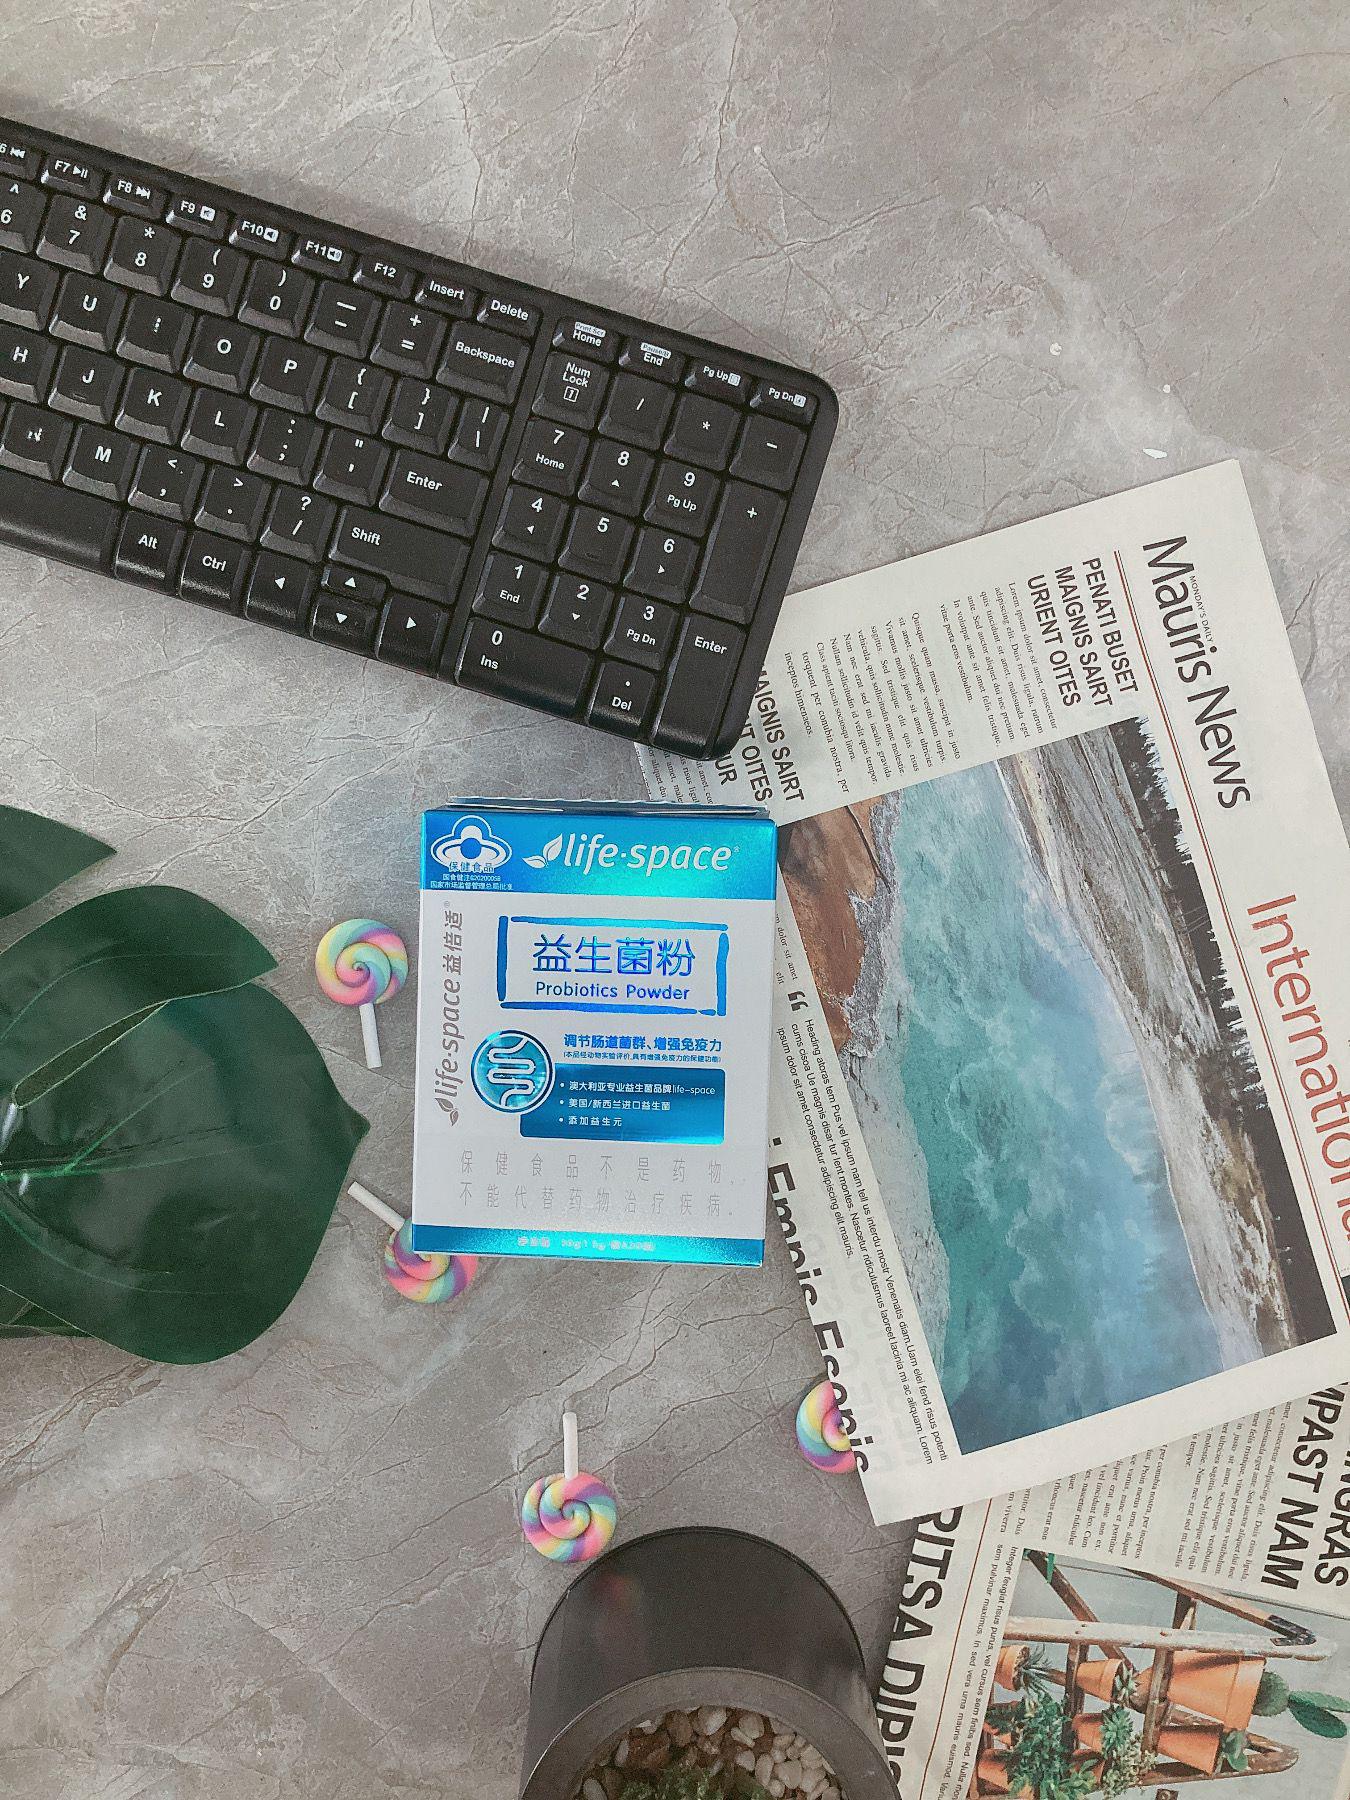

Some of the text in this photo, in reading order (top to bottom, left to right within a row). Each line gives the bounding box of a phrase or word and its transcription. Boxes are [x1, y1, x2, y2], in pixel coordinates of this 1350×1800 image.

[54, 160, 70, 172] F7
[118, 179, 132, 193] F8
[181, 200, 195, 213] F9
[1, 209, 12, 223] 6
[242, 221, 264, 236] F10
[69, 230, 80, 244] 7
[305, 240, 327, 256] F11
[135, 252, 146, 266] 8
[374, 263, 396, 277] F12
[18, 273, 29, 289] Y
[203, 274, 214, 288] 9
[430, 280, 464, 299] Insert
[83, 295, 97, 311] U
[270, 296, 281, 310] 0
[491, 299, 529, 321] Delete
[572, 329, 602, 347] Home
[13, 347, 28, 362] H
[217, 339, 231, 354] O
[456, 341, 514, 367] Backspace
[284, 360, 297, 373] P
[643, 352, 664, 367] End
[82, 370, 94, 383] J
[566, 362, 591, 378] Num
[703, 366, 729, 381] Pg Up
[562, 373, 589, 388] Lock
[147, 389, 162, 406] K
[769, 388, 794, 402] Pg Dn
[215, 411, 224, 426] L
[554, 430, 564, 444] 7
[95, 446, 111, 462] M
[536, 453, 564, 469] Home
[618, 451, 629, 466] 8
[407, 471, 442, 490] Enter
[684, 472, 695, 486] 9
[532, 498, 542, 512] 4
[667, 494, 696, 511] Pg Up
[597, 517, 609, 532] 5
[138, 535, 157, 549] Alt
[352, 527, 380, 545] Shift
[664, 539, 674, 553] 6
[203, 556, 226, 571] Ctrl
[515, 565, 523, 579] 1
[500, 590, 520, 603] End
[577, 585, 589, 600] 2
[643, 606, 654, 620] 3
[1189, 575, 1214, 643] MONDAY'S DAILY
[1082, 557, 1139, 692] PENATI BUSET
[492, 631, 502, 645] 0
[627, 629, 655, 645] Pg Dn
[1027, 574, 1082, 707] URIENT OITES
[1054, 565, 1113, 706] MAIGNIS SAIRT
[695, 636, 727, 654] Enter
[481, 655, 498, 669] Ins
[1142, 535, 1251, 809] Mauris News
[612, 697, 632, 714] Del
[754, 670, 805, 801] AIGNIS SAIRT
[741, 745, 773, 801] OITES
[448, 861, 495, 873] 保健食品
[443, 910, 463, 976] 益倍适
[533, 931, 696, 979] 益生菌粉
[535, 980, 690, 1001] Probiotics Powder
[563, 1033, 722, 1052] 调节肠道菌群、增强免疫力
[791, 1023, 804, 1048] cums
[804, 1018, 822, 1056] Heading
[785, 1055, 798, 1077] dolor
[792, 1078, 803, 1090] sit
[796, 1090, 811, 1114] amet
[810, 1087, 827, 1120] magnis
[568, 1115, 623, 1127] 添加益生元
[831, 1104, 842, 1123] Pus
[837, 1123, 849, 1138] vel
[804, 1114, 826, 1165] consectetur
[840, 1138, 856, 1166] ipsum
[850, 1167, 863, 1188] nam
[838, 1175, 854, 1212] montes.
[834, 1211, 845, 1226] elit
[849, 1212, 868, 1252] Nascetur
[885, 1274, 904, 1320] Venenatis
[880, 1309, 897, 1342] laoreet
[889, 1341, 904, 1371] lacinia
[898, 1371, 908, 1383] mi
[902, 1384, 912, 1396] ac
[906, 1397, 923, 1435] aliquam.
[918, 1435, 933, 1465] Lorem
[1260, 1496, 1319, 1590] NAM
